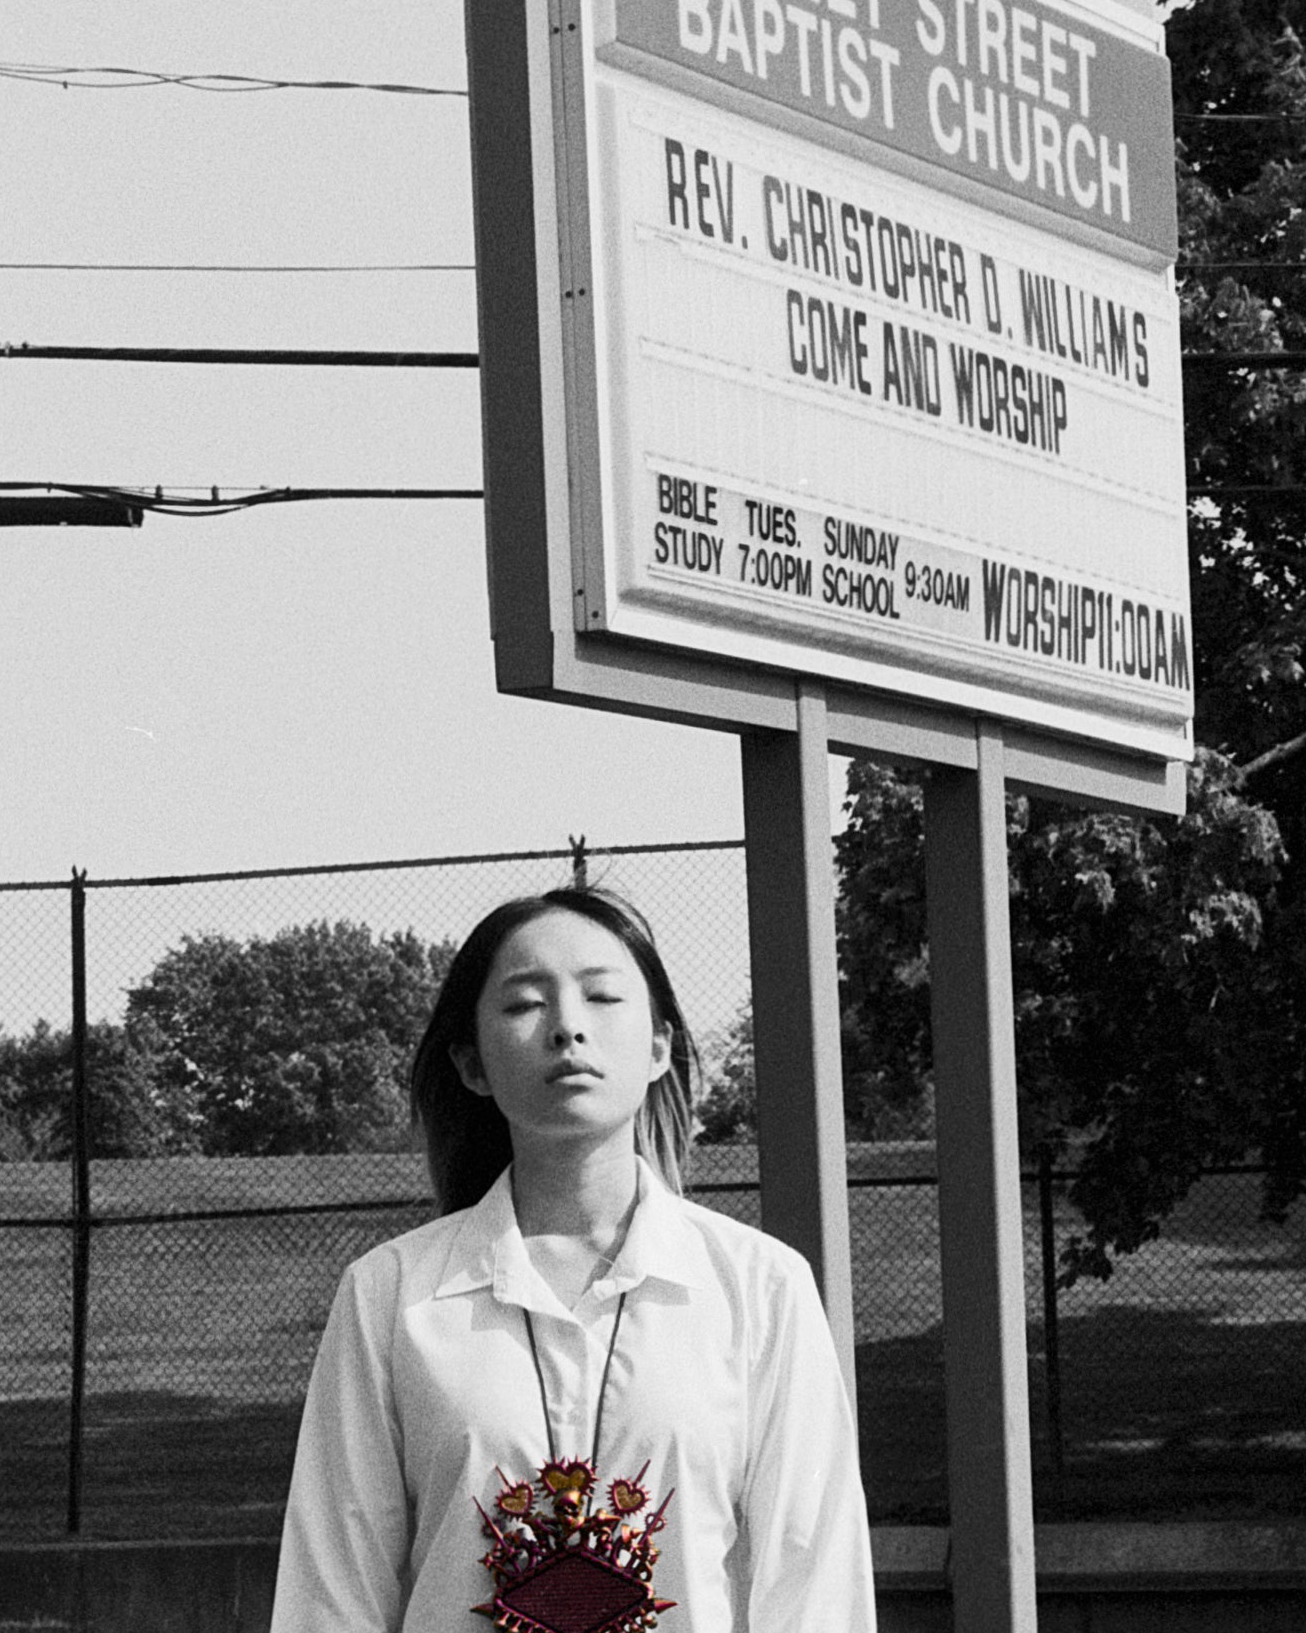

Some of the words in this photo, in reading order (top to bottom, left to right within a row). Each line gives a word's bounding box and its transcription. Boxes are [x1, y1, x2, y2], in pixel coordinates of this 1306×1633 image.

[927, 69, 1131, 223] CHURCH
[665, 137, 748, 250] REV.
[763, 174, 971, 325] CHRISTOPHER
[980, 253, 1013, 340] D.
[1019, 268, 1149, 388] WILLIAMS
[786, 288, 872, 396] COME
[883, 321, 942, 417] AND
[950, 342, 1068, 455] WORSHIP
[654, 521, 724, 575] STUDY
[738, 543, 812, 597] 7:00PM
[822, 563, 900, 620] SCHOOL
[904, 560, 970, 612] 9:30AM
[658, 473, 718, 526] BIBLE
[744, 499, 801, 548] TUES.
[823, 516, 899, 571] SUNDAY
